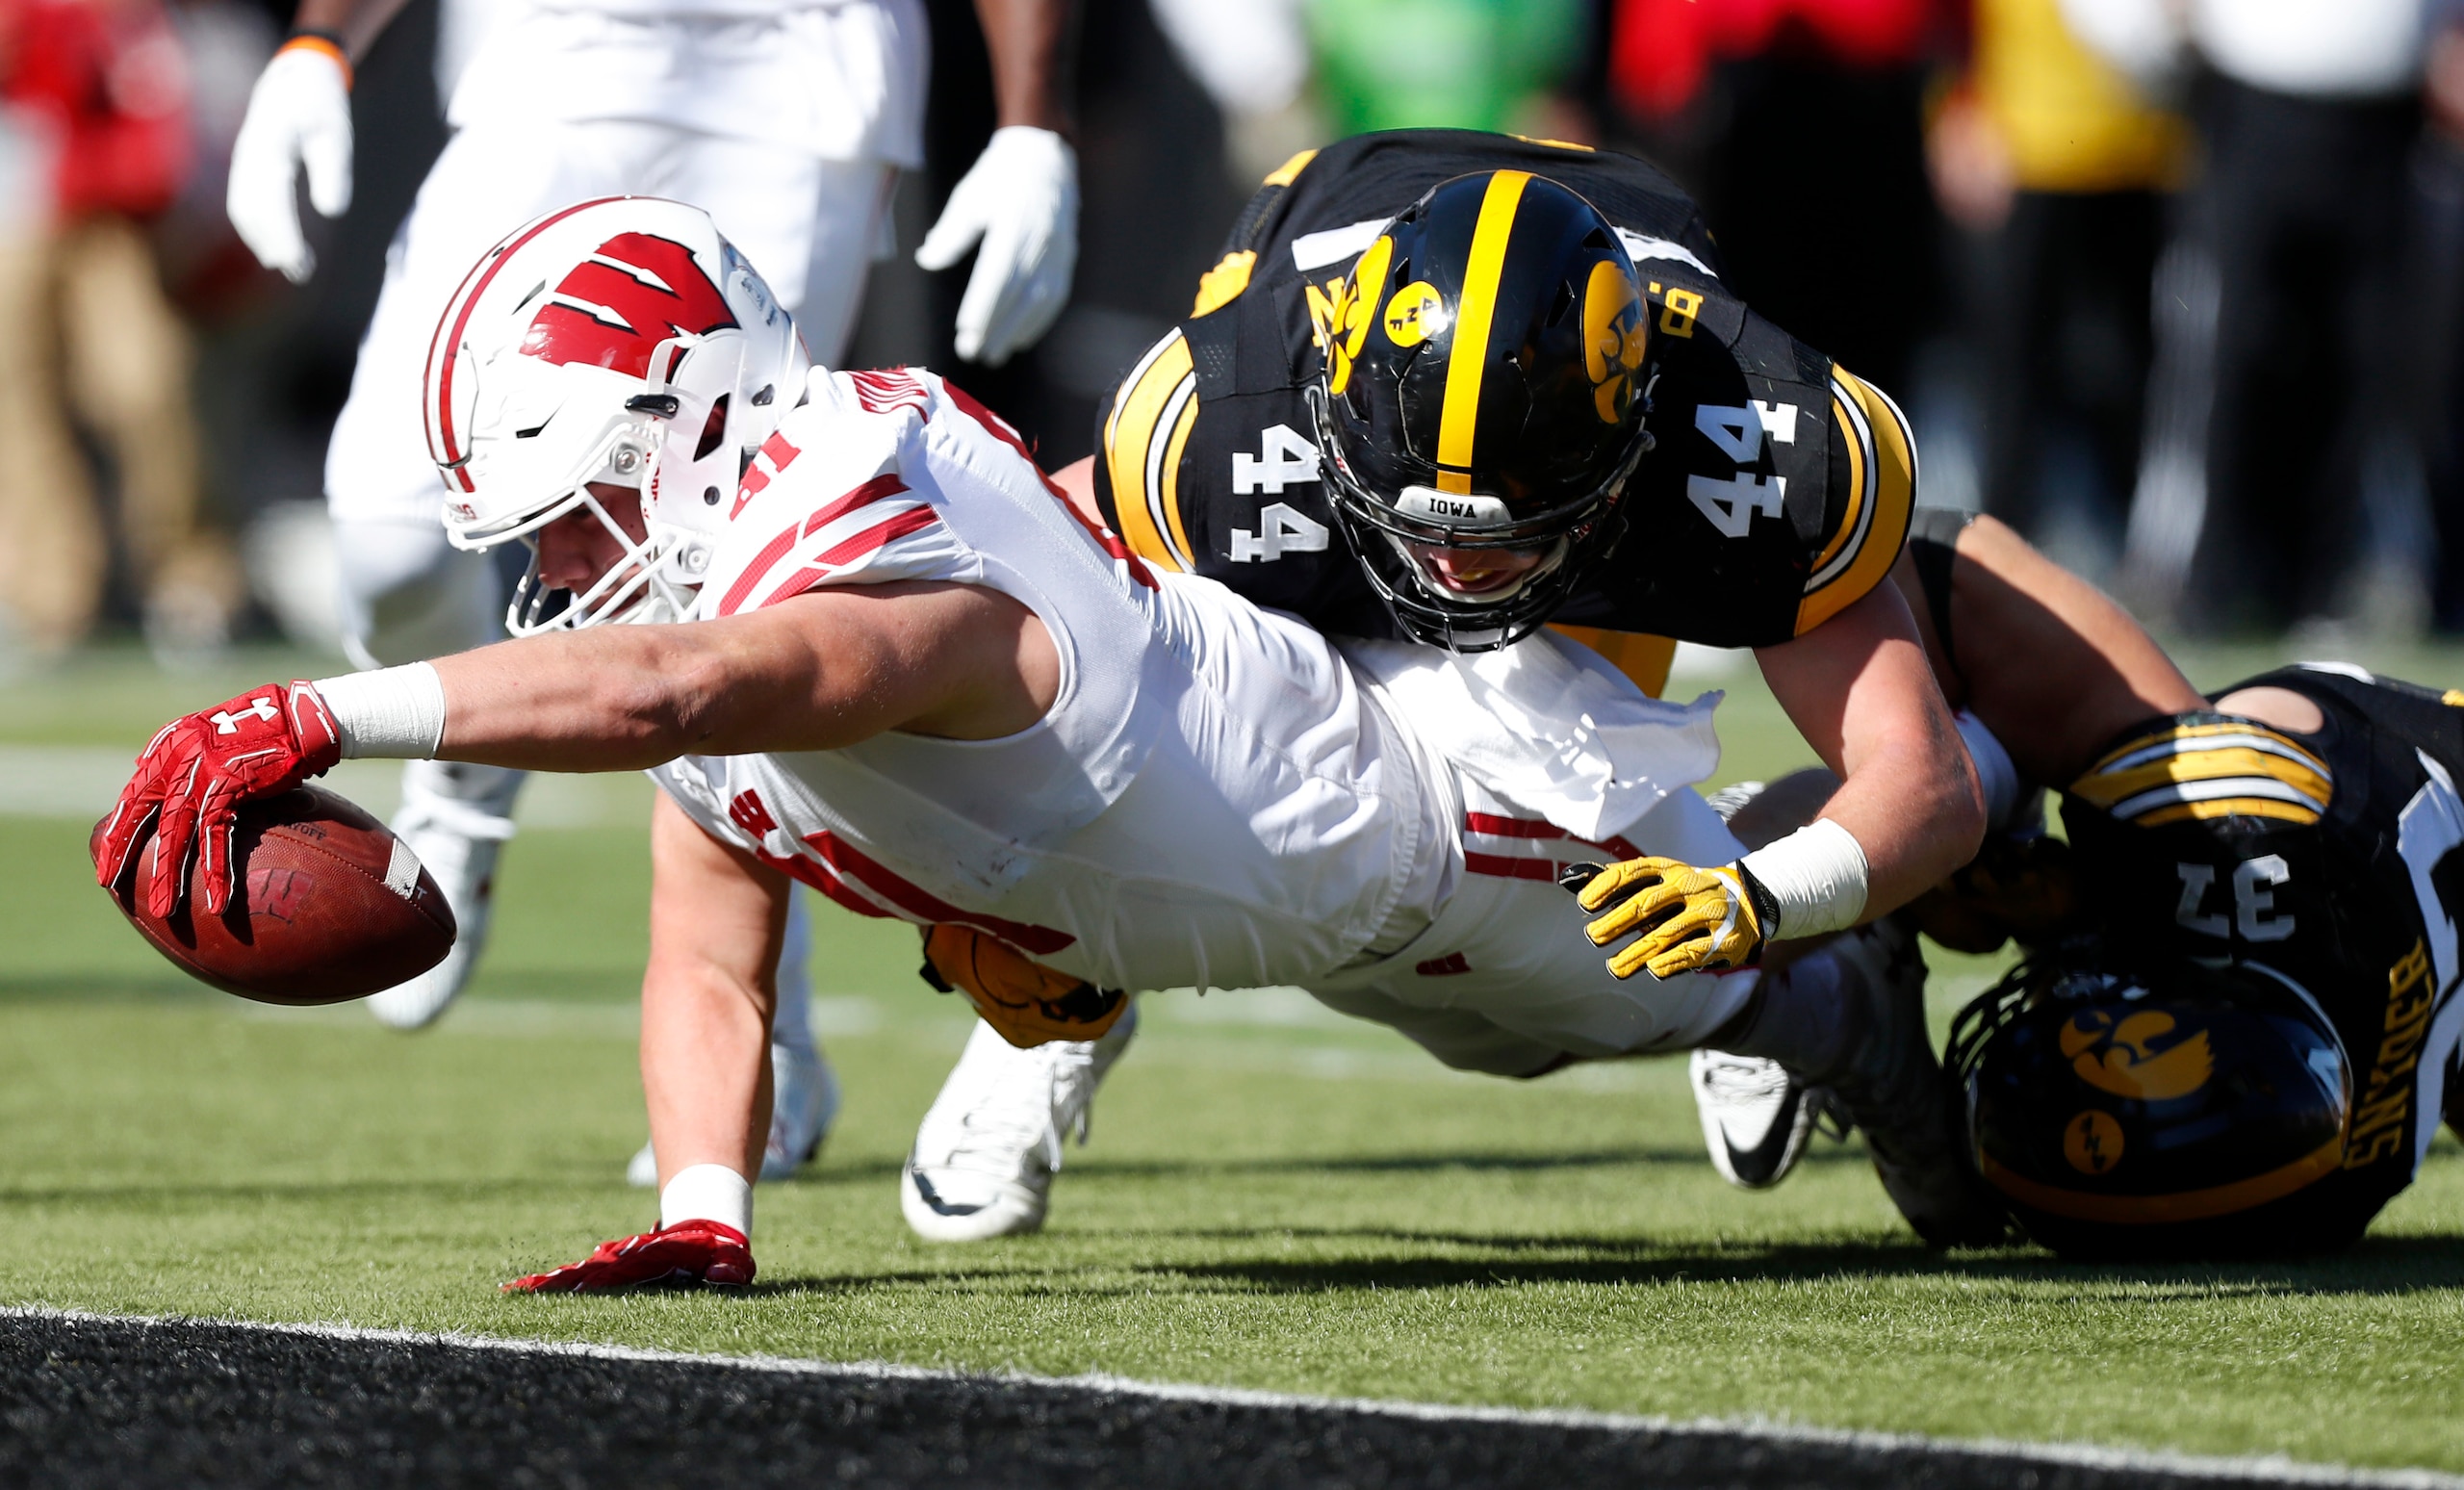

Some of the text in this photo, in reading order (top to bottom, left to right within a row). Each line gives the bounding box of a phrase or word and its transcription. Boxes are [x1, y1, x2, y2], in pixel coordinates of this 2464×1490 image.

[1230, 424, 1329, 562] 44
[1429, 498, 1476, 518] IOWA
[1687, 398, 1798, 538] 44
[2176, 854, 2296, 941] 37
[2344, 937, 2434, 1170] SNYDER
